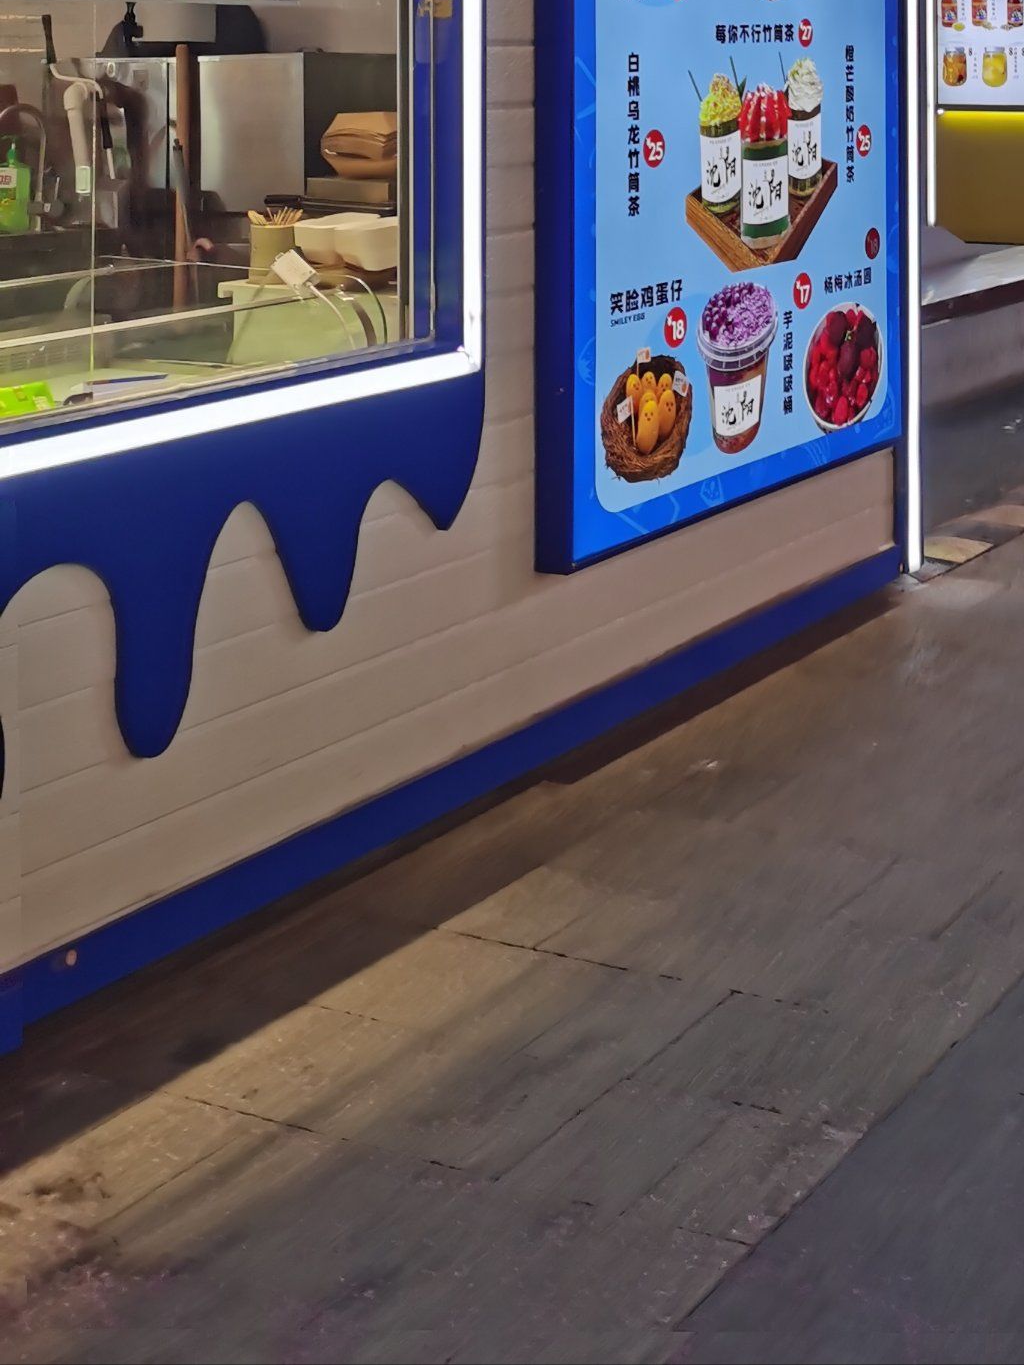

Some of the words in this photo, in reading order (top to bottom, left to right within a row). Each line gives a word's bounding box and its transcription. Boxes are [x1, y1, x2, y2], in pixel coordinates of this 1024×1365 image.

[715, 24, 795, 44] 莓你不行竹筒茶
[627, 53, 640, 217] 白桃乌龙竹筒茶
[610, 279, 683, 315] 笑脸鸡蛋仔
[610, 316, 632, 327] SMILEY
[633, 313, 646, 322] EGG
